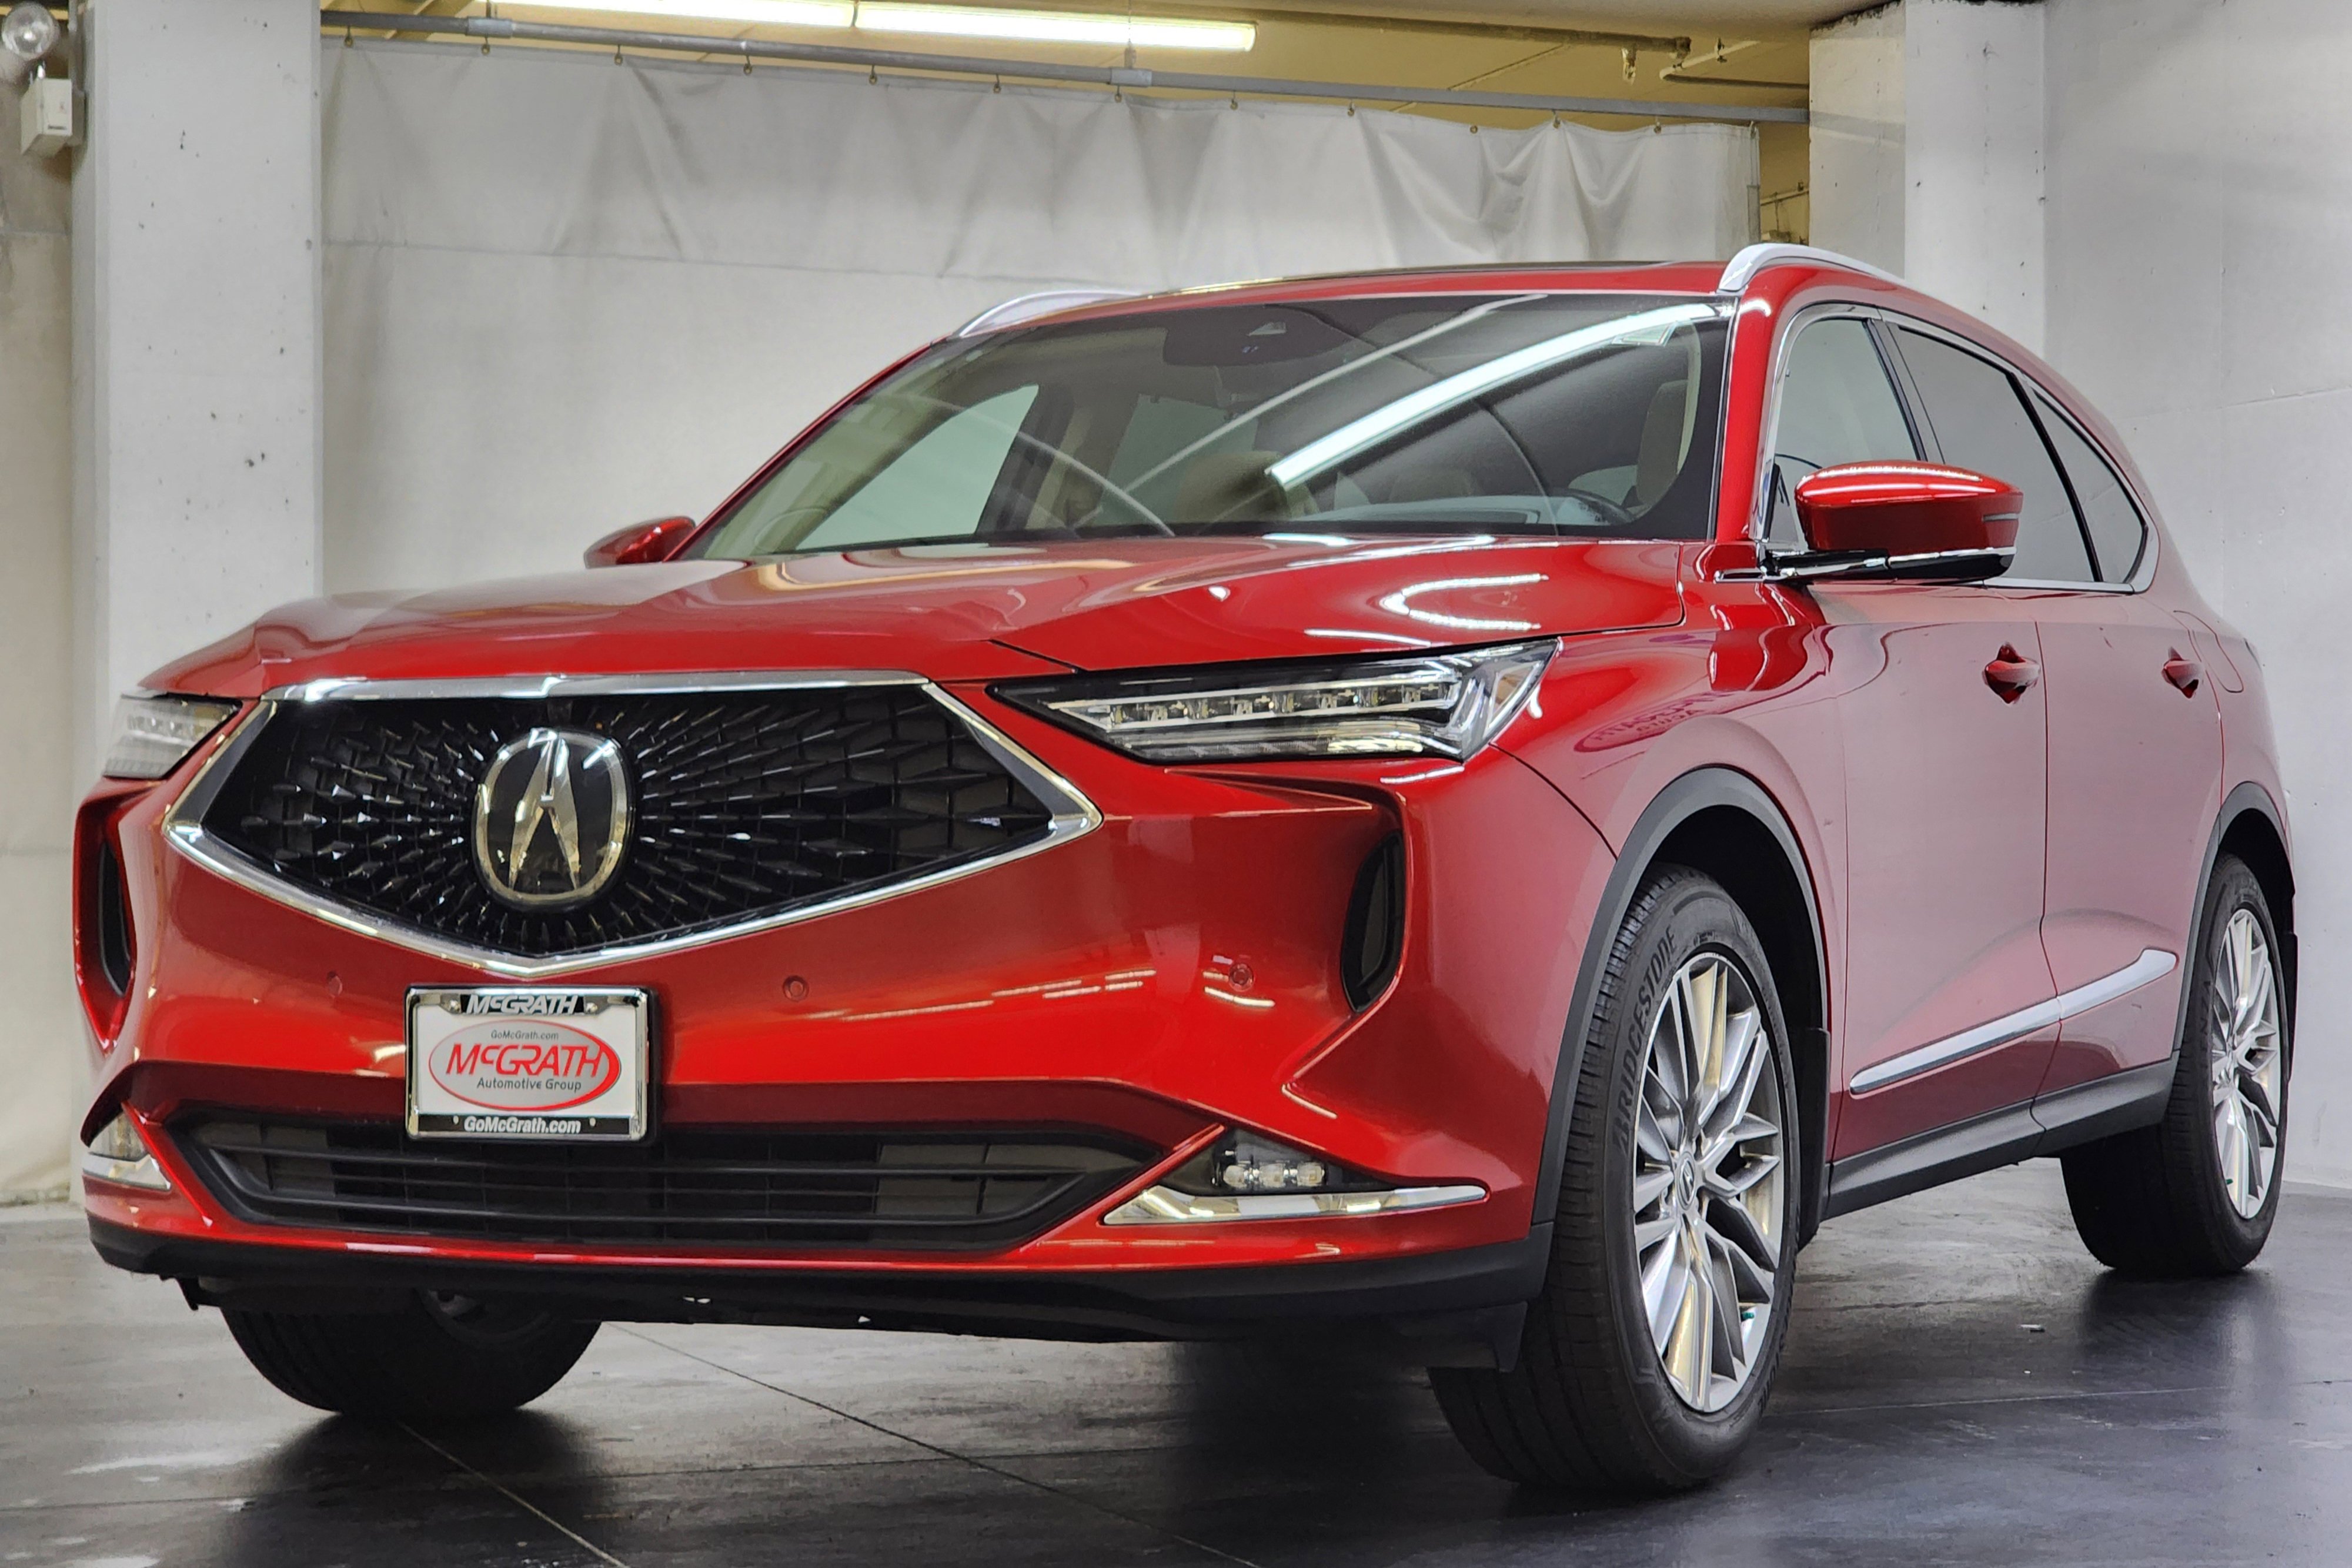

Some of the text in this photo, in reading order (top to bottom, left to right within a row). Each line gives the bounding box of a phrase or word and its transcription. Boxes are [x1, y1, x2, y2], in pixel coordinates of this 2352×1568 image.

[491, 1029, 559, 1041] GoMcGrath.com
[1612, 924, 1678, 1156] BRIDGESTONE
[477, 1076, 582, 1094] Automotive Group
[463, 1116, 582, 1134] GoMcGrath.com
